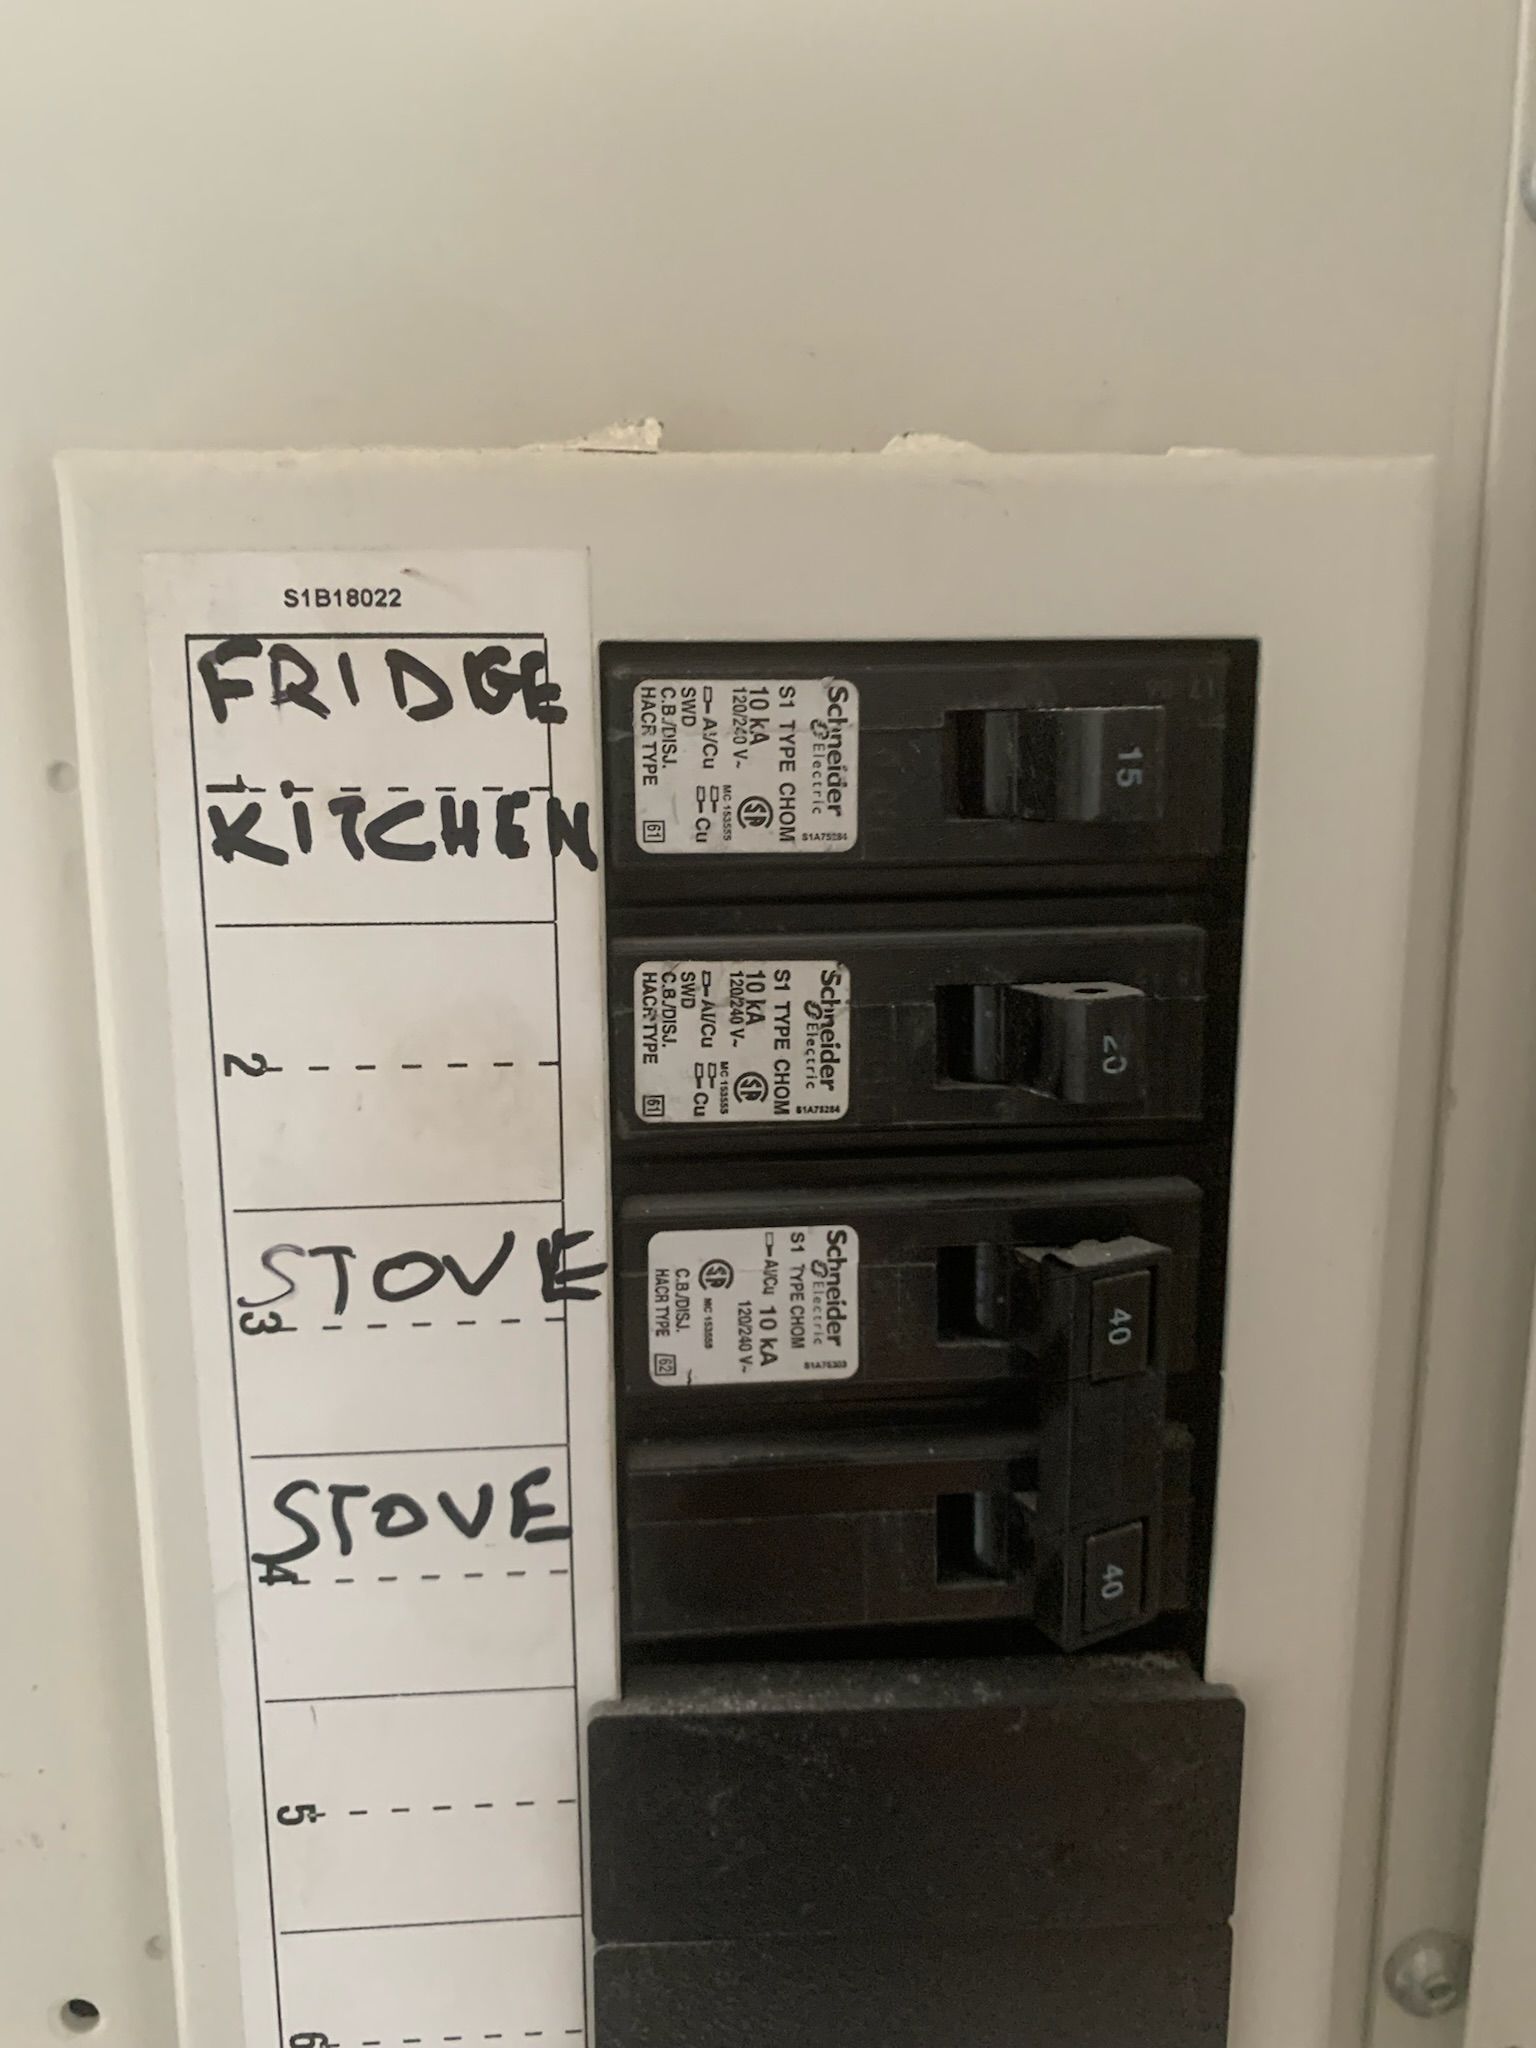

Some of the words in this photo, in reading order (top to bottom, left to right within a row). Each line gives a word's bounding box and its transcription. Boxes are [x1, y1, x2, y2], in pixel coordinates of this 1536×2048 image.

[283, 588, 402, 608] S1B18022
[197, 637, 568, 724] FRIDGE
[749, 687, 770, 710] 10
[779, 685, 796, 709] S1
[641, 687, 657, 736] HACR
[681, 687, 697, 727] SWD
[732, 687, 748, 745] 120/240
[661, 687, 677, 769] C.B./DISJ.
[749, 719, 770, 746] kA
[779, 720, 795, 772] TYPE
[642, 741, 658, 786] TYPE
[827, 686, 849, 817] Schneider
[1117, 746, 1143, 787] 15
[723, 785, 732, 801] MC
[812, 744, 825, 815] Electric
[647, 824, 661, 839] 61
[695, 818, 711, 843] Cu
[779, 782, 795, 842] CHOM
[642, 972, 657, 1019] HACR
[681, 971, 696, 1009] SWD
[729, 971, 744, 1024] 120/240
[746, 970, 766, 993] 10
[774, 969, 791, 991] S1
[662, 971, 677, 1048] C.B./DISJ.
[701, 999, 716, 1048] Al/Cu
[746, 999, 766, 1025] kA
[774, 1001, 790, 1050] TYPE
[643, 1023, 658, 1064] TYPE
[820, 970, 841, 1092] Schneider
[223, 1053, 267, 1077] 2
[720, 1061, 728, 1077] MC
[806, 1023, 819, 1089] Electric
[647, 1098, 661, 1113] 61
[694, 1093, 709, 1116] Cu
[774, 1059, 790, 1115] CHOM
[790, 1232, 805, 1252] S1
[237, 1229, 608, 1315] STOVE
[655, 1269, 669, 1303] HACR
[763, 1259, 778, 1295] Al/Cu
[790, 1264, 805, 1301] TYPE
[826, 1230, 847, 1346] Schneider
[675, 1268, 690, 1333] C.B./DISJ.
[704, 1298, 713, 1313] MC
[760, 1306, 777, 1330] 10
[812, 1282, 824, 1345] Electric
[239, 1311, 282, 1335] 3
[656, 1306, 670, 1337] TYPE
[738, 1300, 752, 1353] 120/240
[790, 1307, 805, 1349] CHOM
[1108, 1307, 1132, 1346] 40
[659, 1358, 672, 1372] 62
[760, 1338, 778, 1367] kA
[251, 1467, 572, 1565] STOVE
[1101, 1563, 1125, 1600] 40
[277, 1803, 317, 1826] 5
